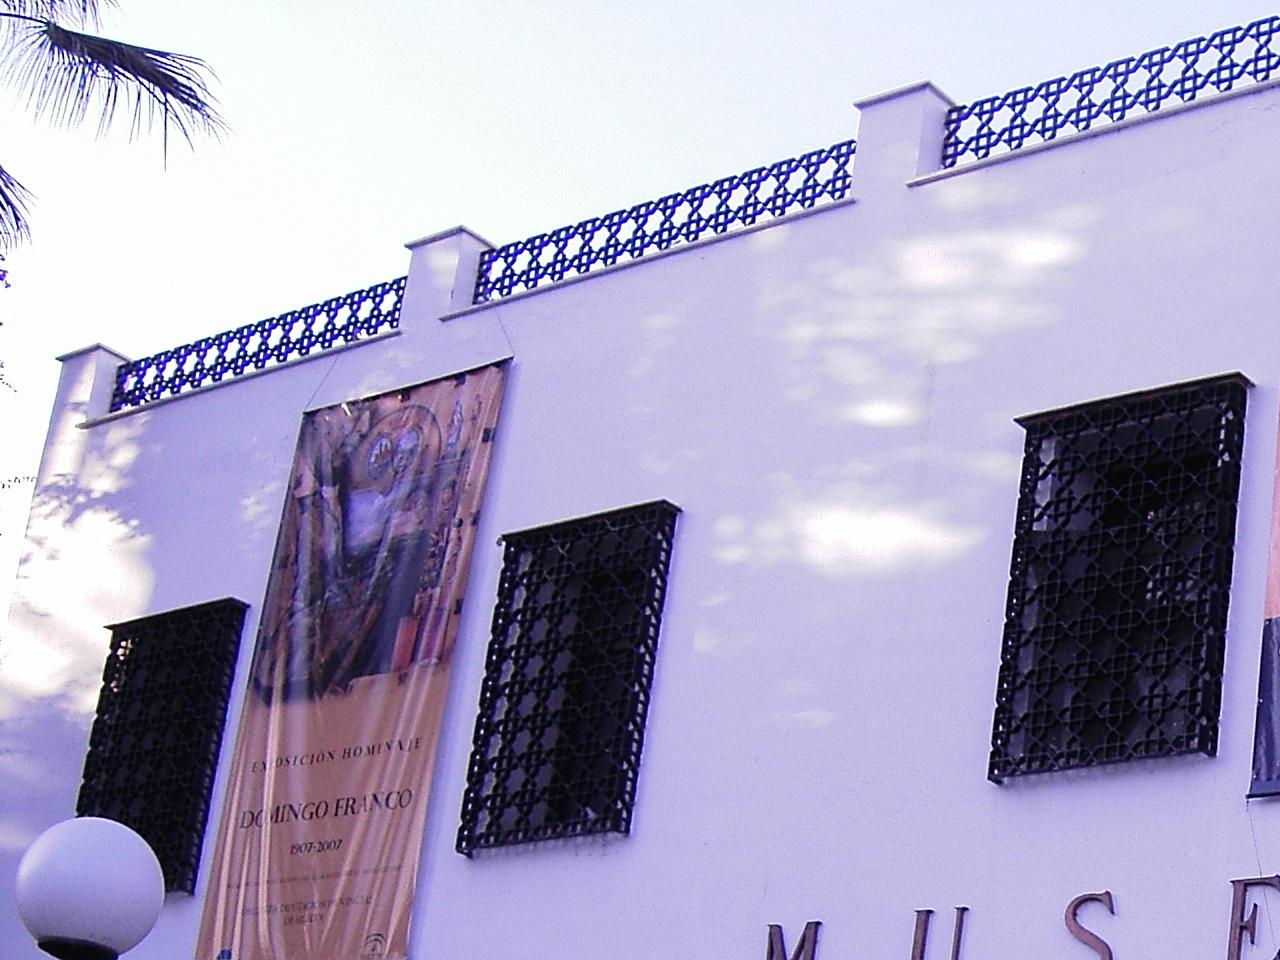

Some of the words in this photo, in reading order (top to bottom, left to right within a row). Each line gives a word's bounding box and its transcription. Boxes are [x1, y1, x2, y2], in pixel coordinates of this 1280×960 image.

[251, 750, 336, 773] EXOSICION
[240, 800, 329, 830] DOMINGO
[334, 788, 413, 818] FRANCO
[289, 838, 344, 855] 1907-2007
